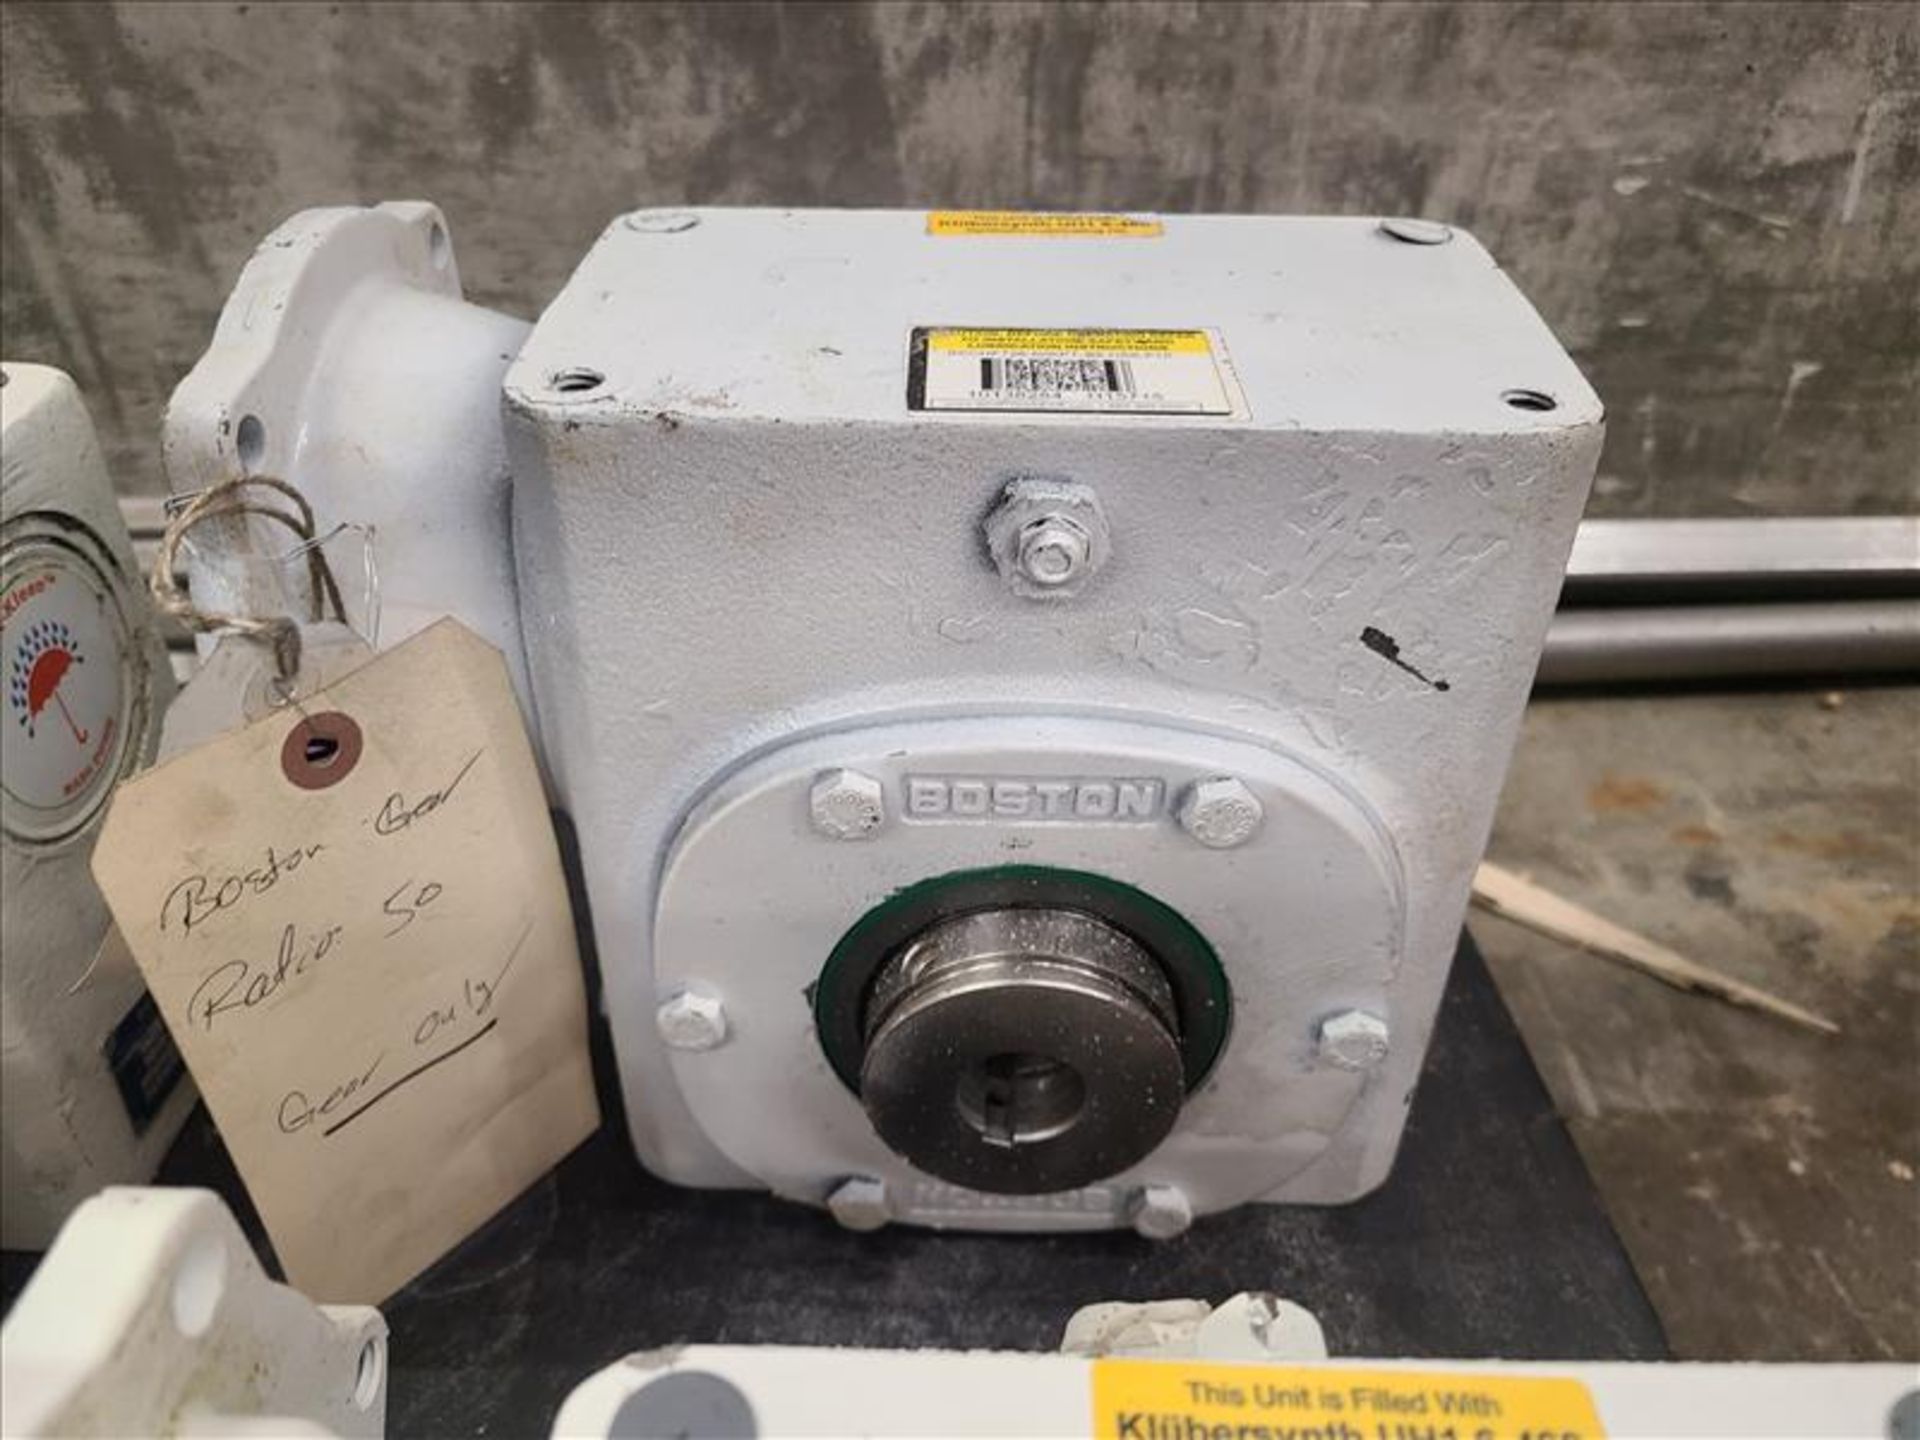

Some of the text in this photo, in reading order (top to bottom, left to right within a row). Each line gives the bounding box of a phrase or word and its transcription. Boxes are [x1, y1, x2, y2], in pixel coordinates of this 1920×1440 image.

[908, 777, 1157, 818] BOSTON
[160, 843, 324, 937] Boston
[1184, 1380, 1503, 1416] This Unit is Filled With
